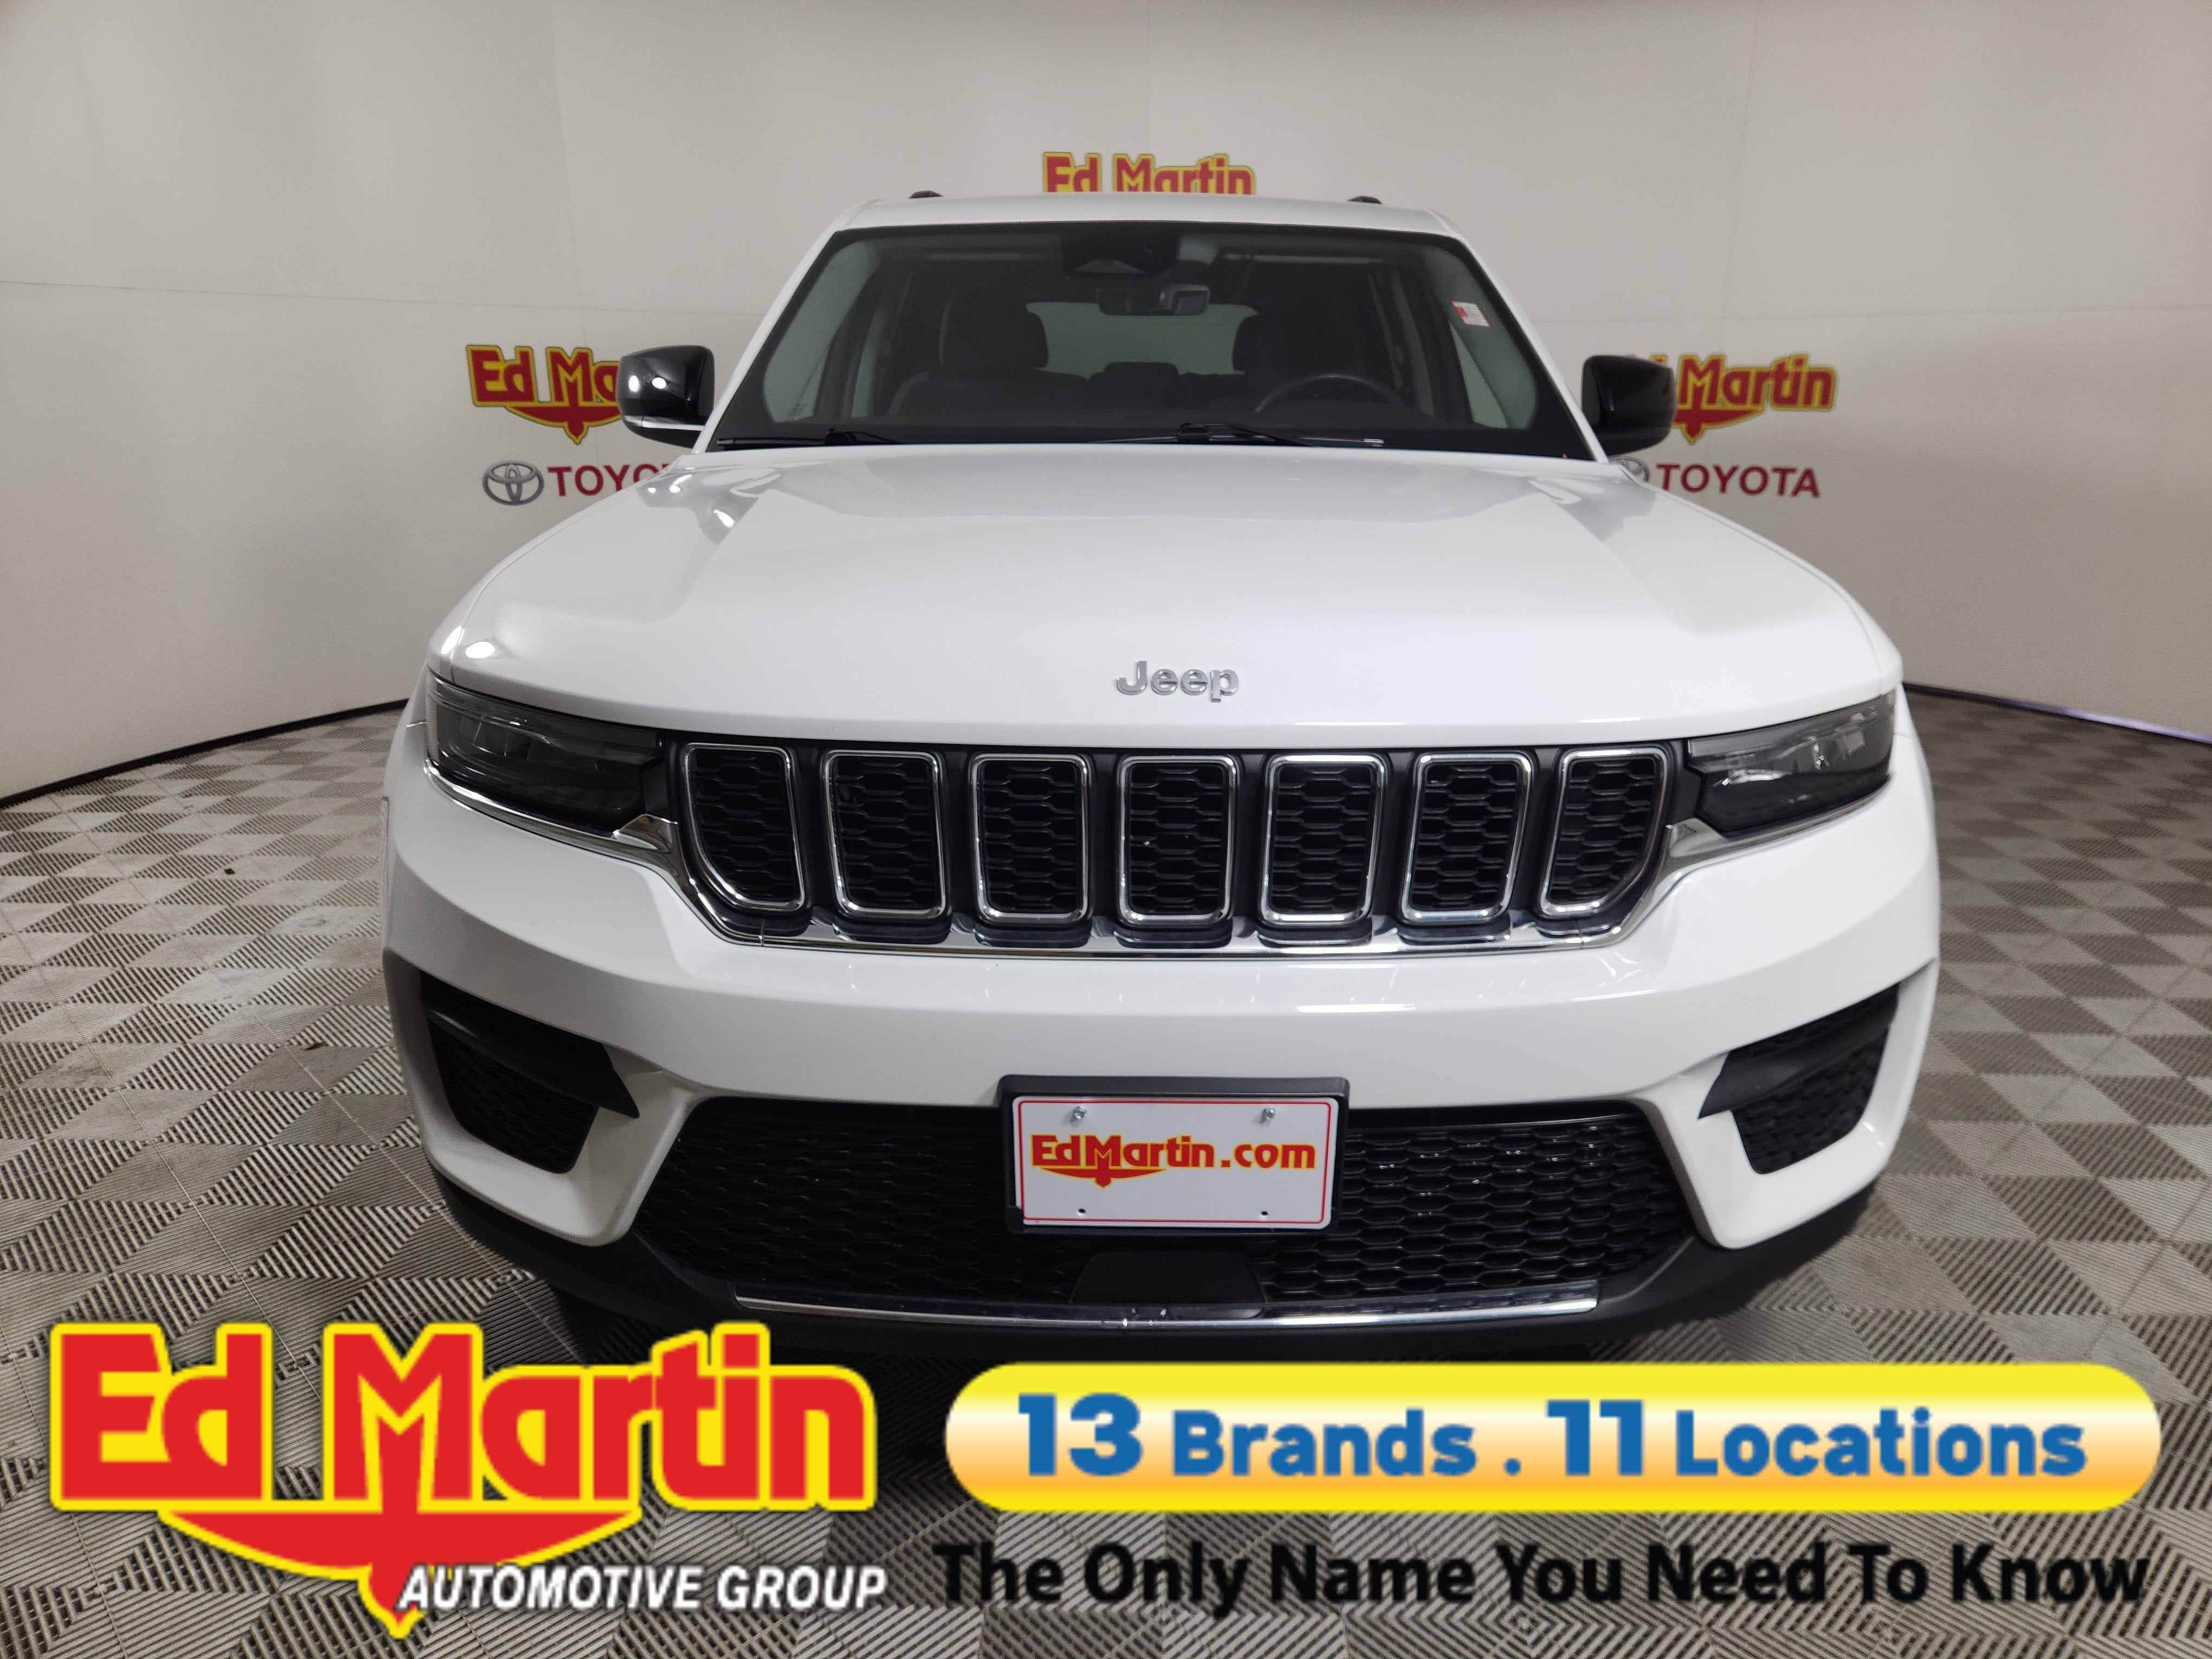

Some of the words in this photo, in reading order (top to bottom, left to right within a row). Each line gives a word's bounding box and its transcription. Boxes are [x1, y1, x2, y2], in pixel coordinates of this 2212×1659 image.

[1044, 152, 1101, 193] Ed
[1113, 153, 1256, 194] Martin
[467, 345, 538, 407] Ed
[1676, 353, 1838, 411] Martin
[548, 463, 672, 497] TOY
[1656, 462, 1821, 498] TOYOTA
[1116, 661, 1239, 703] Jeep
[1030, 1134, 1316, 1170] EdMartin.com
